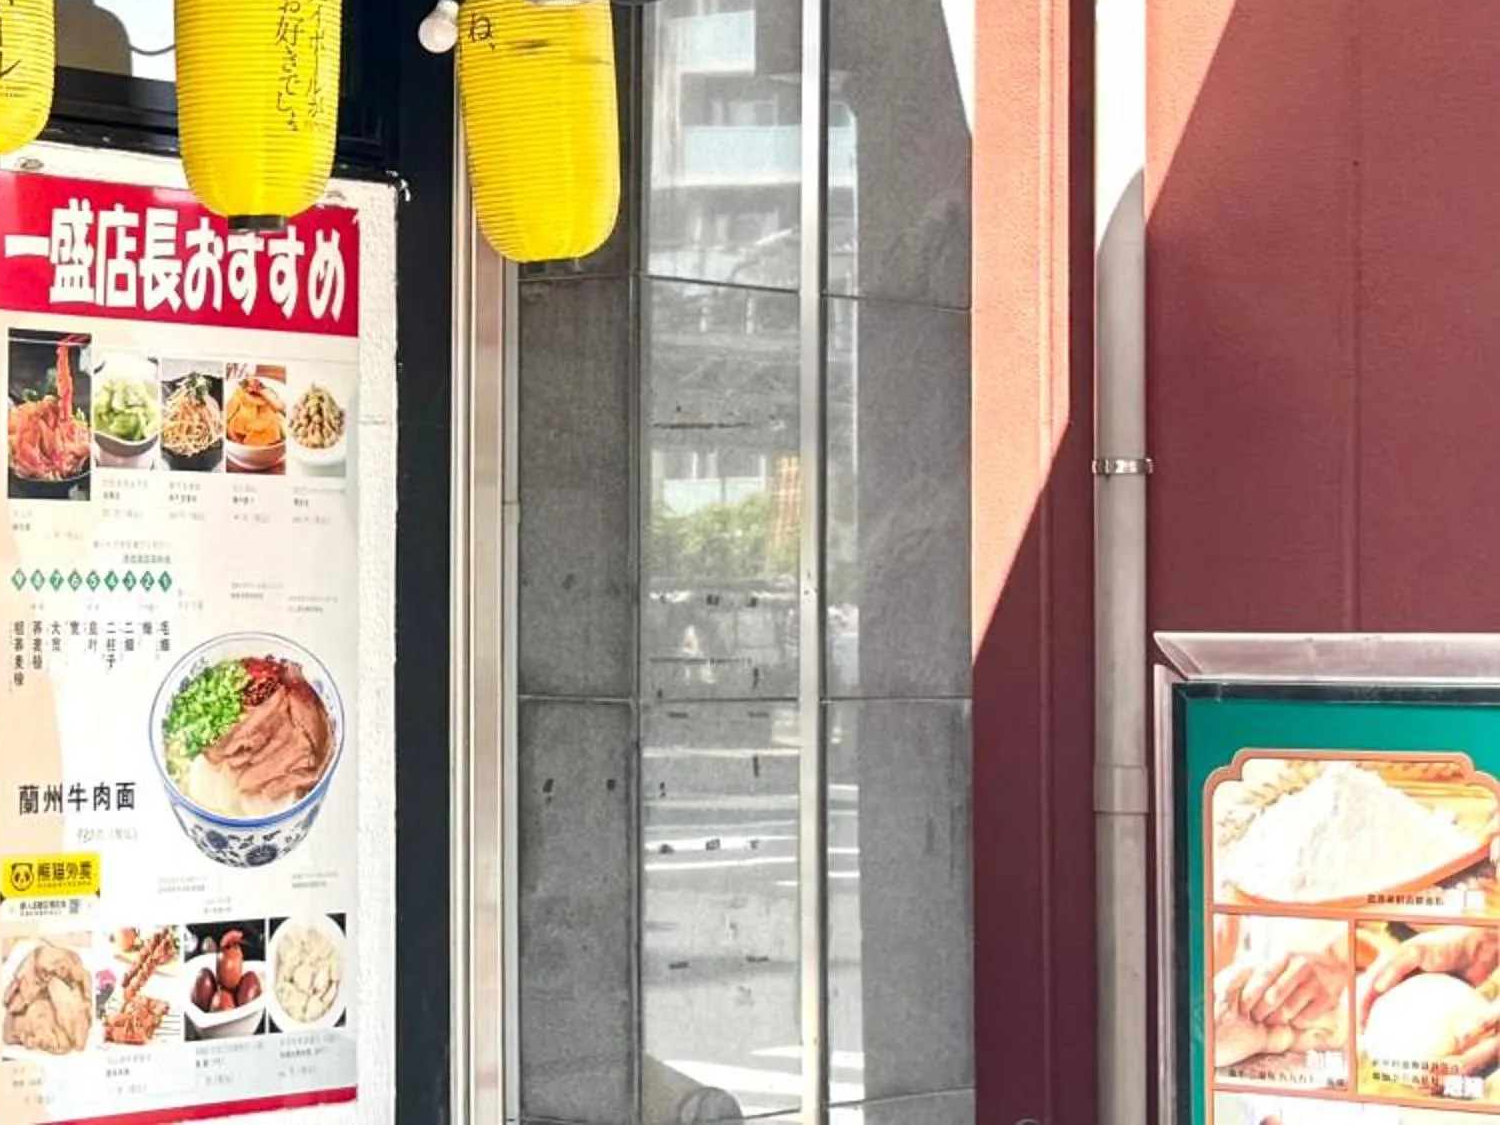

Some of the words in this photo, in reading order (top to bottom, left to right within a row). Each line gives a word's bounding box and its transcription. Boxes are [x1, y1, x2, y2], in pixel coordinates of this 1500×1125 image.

[4, 197, 347, 323] 一盛店長おすすめ
[18, 781, 136, 816] 蘭州牛肉面
